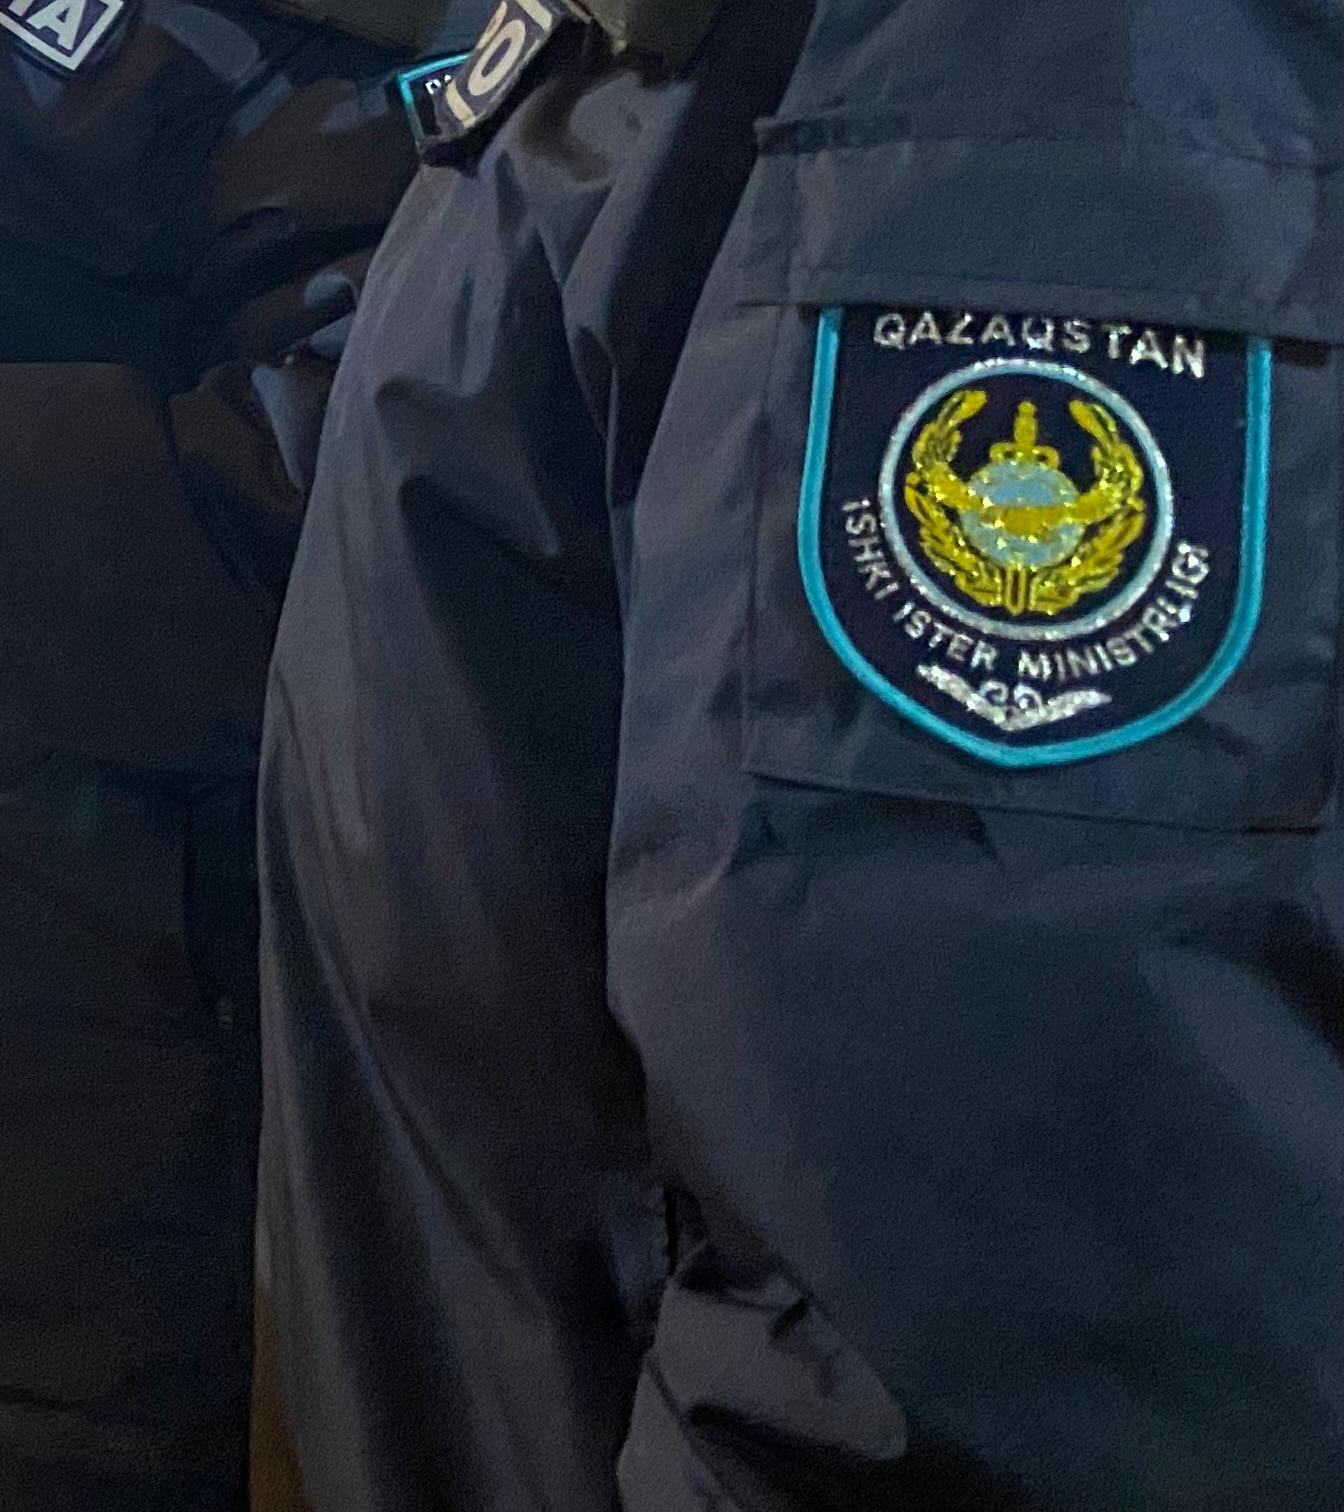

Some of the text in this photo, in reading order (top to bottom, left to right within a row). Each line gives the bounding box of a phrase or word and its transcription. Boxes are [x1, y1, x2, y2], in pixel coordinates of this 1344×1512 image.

[873, 311, 1205, 378] QAZAQSTAN
[842, 499, 900, 600] ISHKI
[893, 601, 997, 671] ISTER
